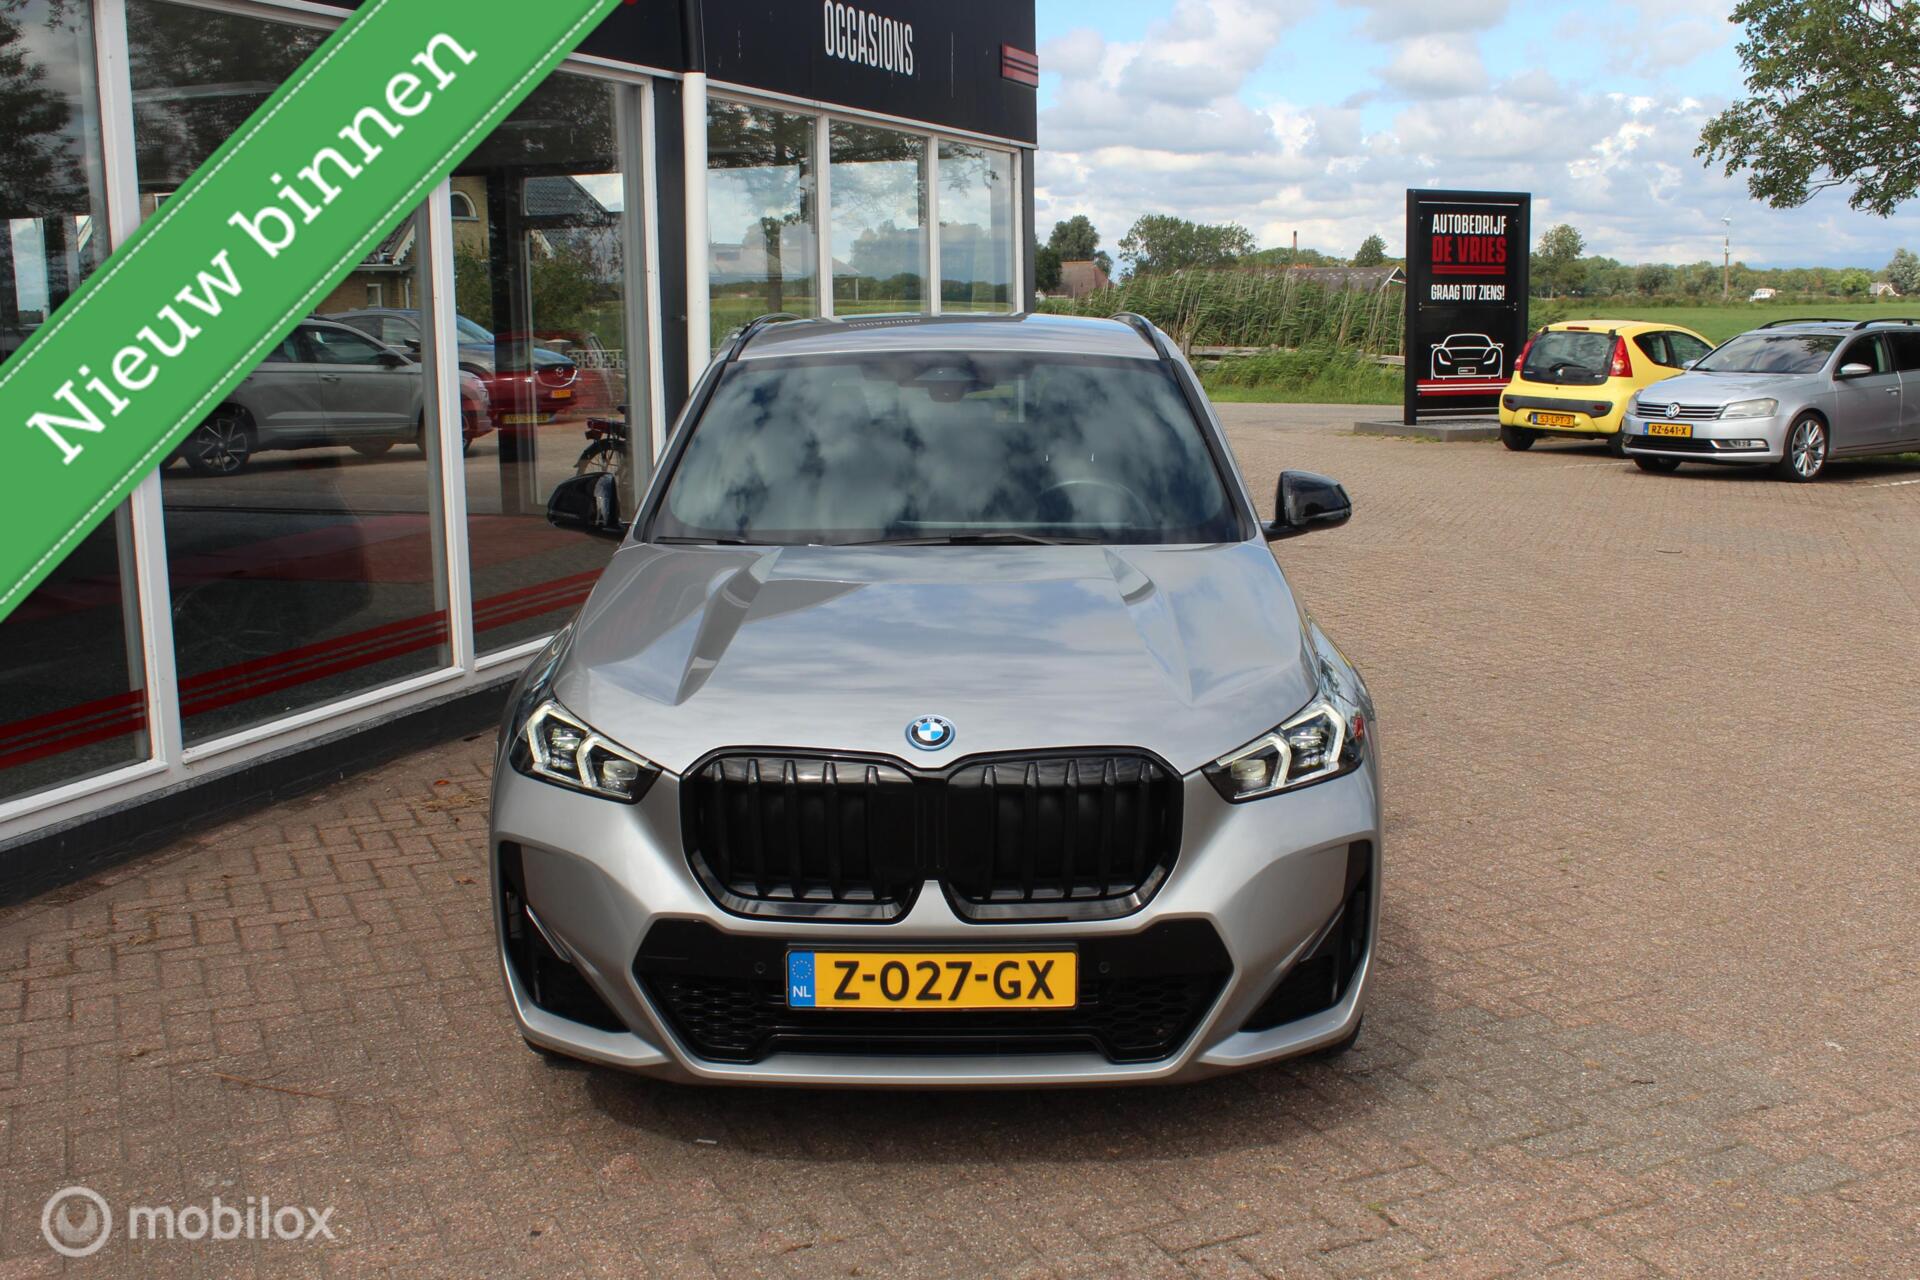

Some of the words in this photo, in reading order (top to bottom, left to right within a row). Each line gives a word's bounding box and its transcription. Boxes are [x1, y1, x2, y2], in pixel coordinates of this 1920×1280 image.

[824, 0, 914, 76] OCCASIONS
[1432, 214, 1507, 235] AUTOBEDRIJF
[1431, 234, 1453, 263] DE
[1457, 235, 1507, 264] VRIES
[1430, 284, 1460, 301] GRAAG
[1461, 284, 1477, 301] TOT
[1478, 284, 1506, 301] ZIENS!
[1651, 425, 1687, 435] RZ-641-X
[792, 985, 812, 998] NL
[833, 959, 1055, 1002] Z-027-GX
